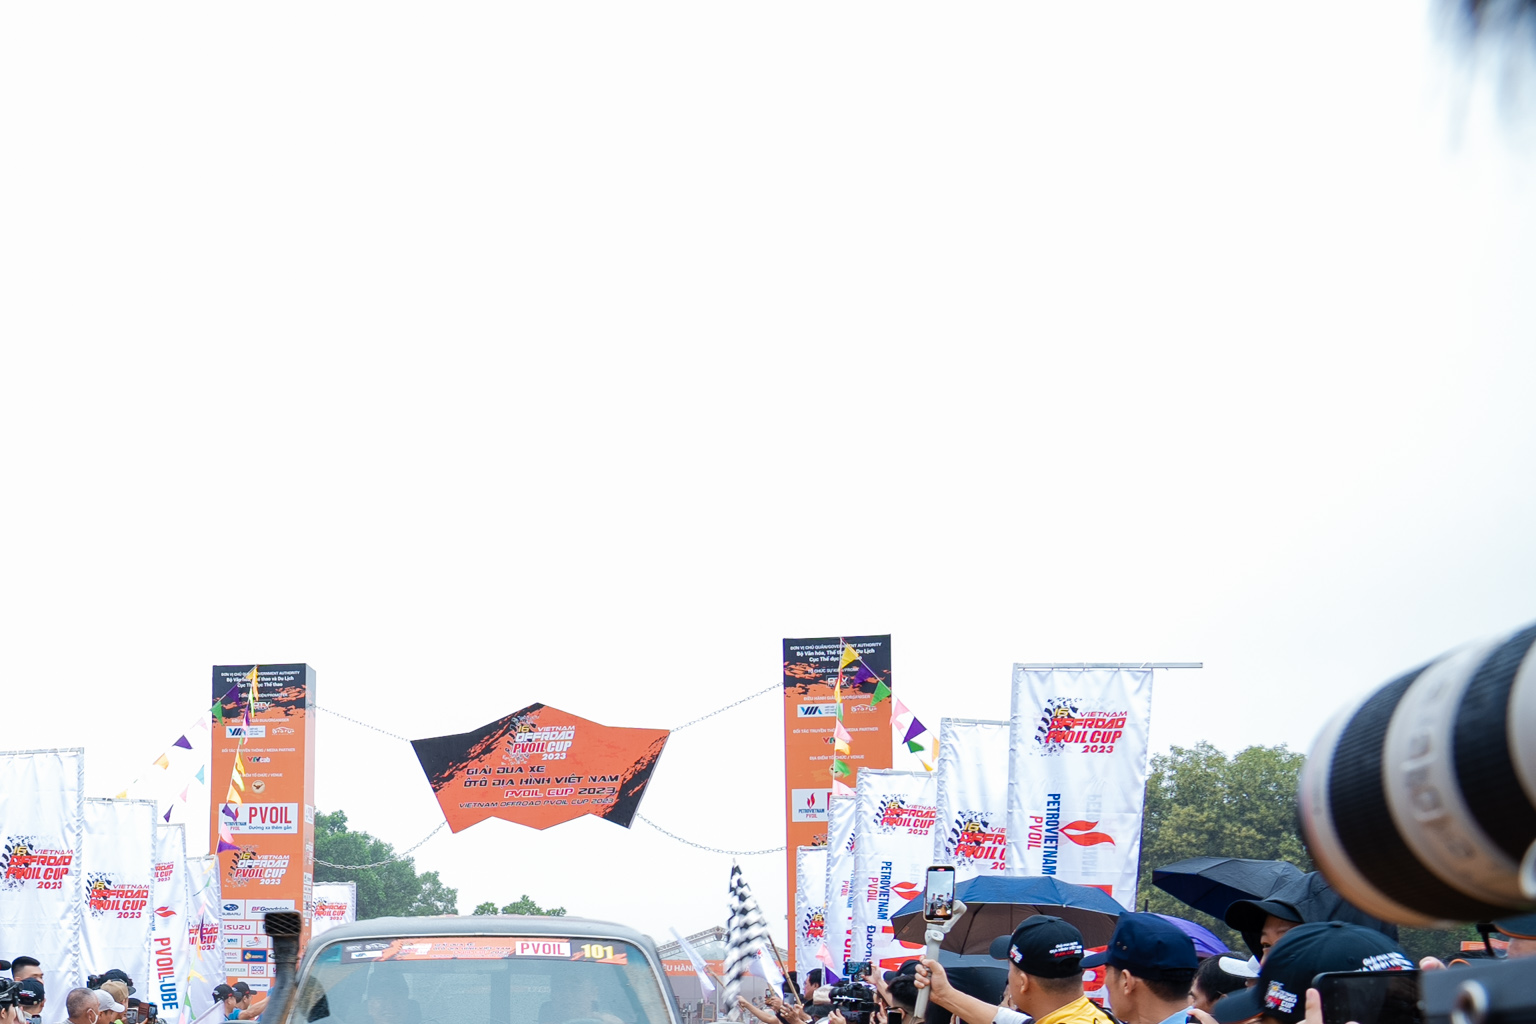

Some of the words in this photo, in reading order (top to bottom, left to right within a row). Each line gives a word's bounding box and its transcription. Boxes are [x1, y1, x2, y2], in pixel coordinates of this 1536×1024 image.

[1054, 708, 1069, 716] 16
[1050, 718, 1126, 729] OFFROAD
[516, 731, 574, 742] OFFROAD
[1095, 730, 1122, 743] CUP
[513, 742, 545, 753] PVOIL
[547, 741, 572, 752] CUP
[1081, 745, 1114, 753] 2023
[466, 765, 492, 775] GIẢI
[496, 766, 524, 774] ĐUA
[464, 777, 488, 787] ÔTÔ
[492, 778, 514, 789] ĐỊA
[520, 775, 551, 785] HÌNH
[555, 773, 583, 786] VIỆT
[504, 789, 544, 798] PVOIL
[546, 788, 574, 797] CUP
[578, 787, 616, 795] 2023
[249, 807, 292, 824] PVOIL
[914, 819, 934, 828] CUP
[964, 821, 980, 831] 16
[1028, 815, 1043, 850] PVOIL
[1042, 793, 1060, 876] PETROVIETNAM
[9, 855, 72, 866] OFFROAD
[238, 860, 289, 868] OFFROAD
[990, 862, 1006, 870] 20
[47, 867, 68, 880] CUP
[235, 868, 263, 878] PVOIL
[264, 868, 286, 878] CUP
[37, 881, 62, 889] 2023
[867, 877, 878, 902] PVOIL
[877, 861, 892, 920] PETROVIETNAM
[91, 890, 148, 899] OFFROAD
[122, 900, 147, 910] CUP
[521, 943, 564, 955] PVOIL
[581, 944, 614, 959] 101
[674, 963, 694, 971] HÀN
